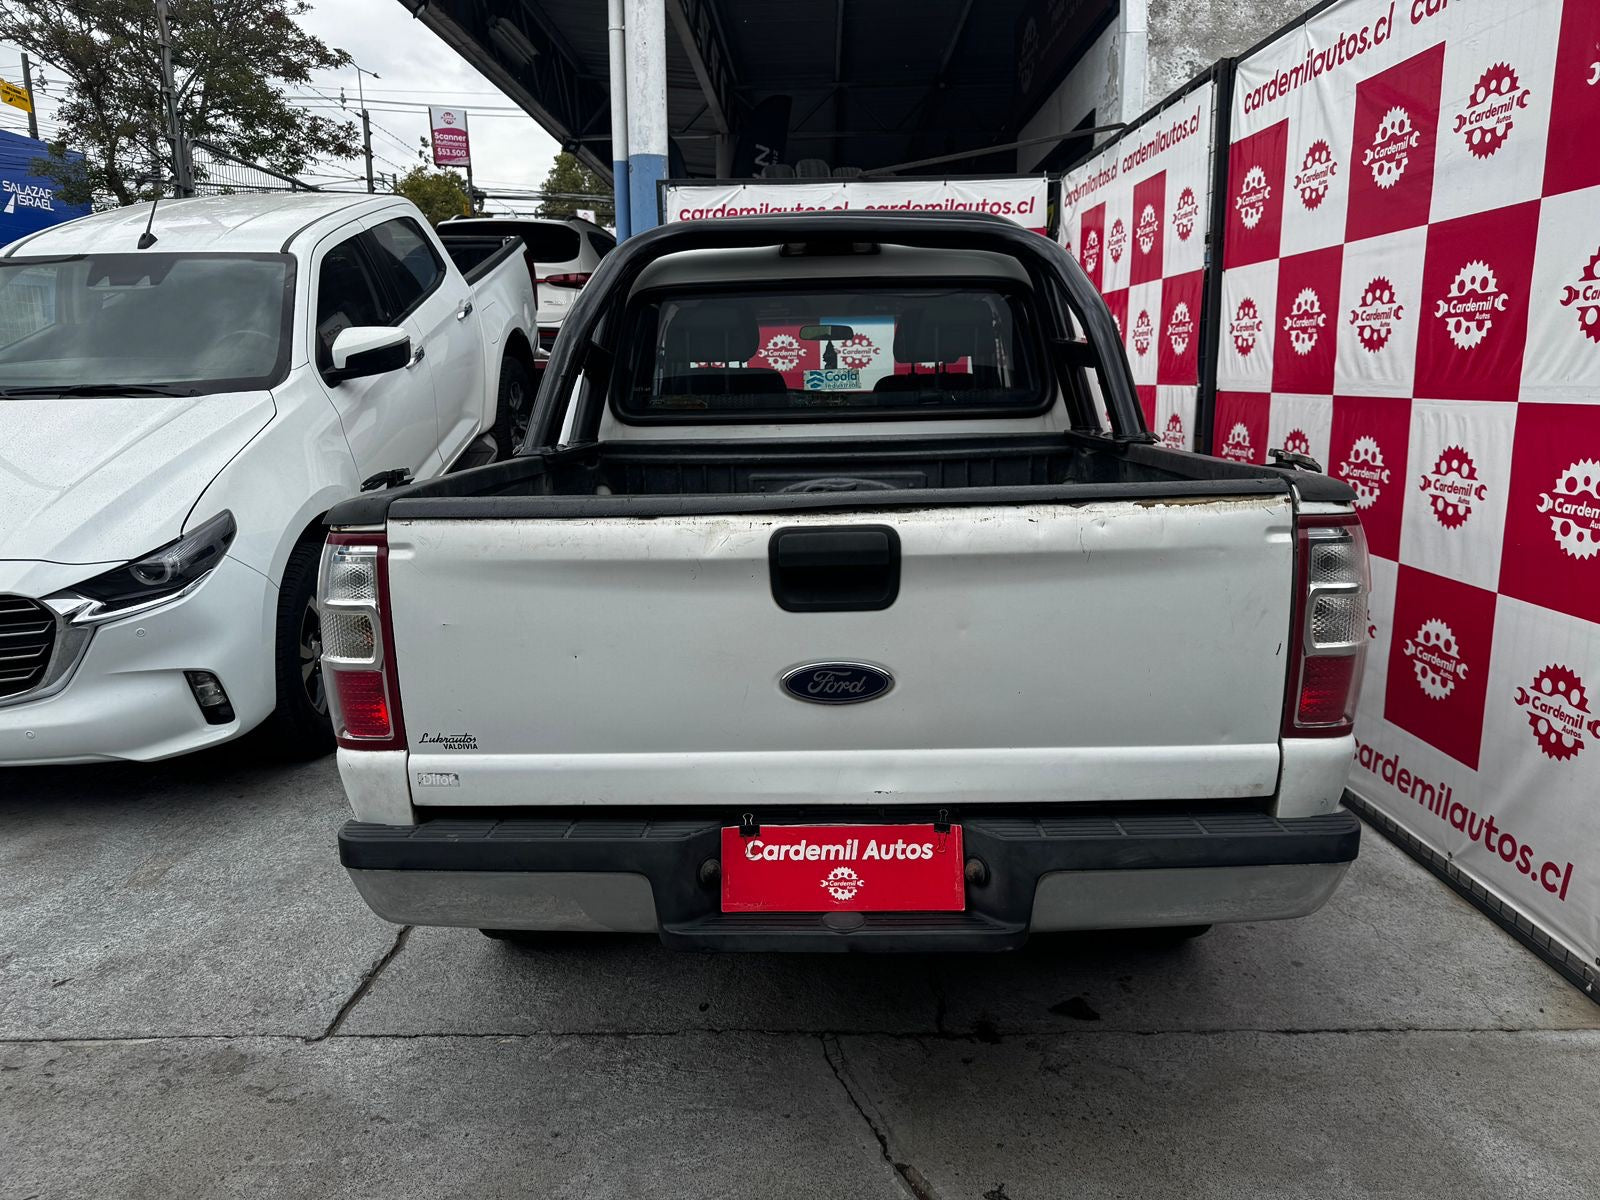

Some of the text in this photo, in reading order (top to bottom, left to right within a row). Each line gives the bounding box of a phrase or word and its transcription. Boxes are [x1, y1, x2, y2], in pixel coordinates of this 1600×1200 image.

[1244, 2, 1395, 115] cardemilautos.cl
[1468, 94, 1515, 126] Cardemil
[1495, 114, 1512, 125] Autos
[434, 132, 466, 142] Scanner
[1122, 105, 1201, 173] cardemilautos.cl
[437, 148, 466, 157] $53.500
[1374, 135, 1409, 160] Cardemil
[1302, 164, 1329, 185] Cardemil
[2, 180, 54, 200] SALAZAR
[17, 194, 54, 211] ISRAEL
[1449, 295, 1493, 314] Cardemil
[1292, 315, 1318, 329] Cardemil
[1360, 306, 1393, 322] Cardemil
[1474, 312, 1491, 321] Autos
[769, 349, 798, 357] Cardemil
[825, 371, 857, 381] Coala
[1350, 465, 1381, 481] Cardemil
[1433, 478, 1473, 497] Cardemil
[1416, 645, 1456, 673] Cardemil
[808, 670, 867, 694] Ford
[1532, 696, 1585, 730] Cardemil
[1561, 725, 1582, 739] Autos
[745, 839, 934, 862] Cardemil Autos
[830, 879, 857, 887] Cardemil
